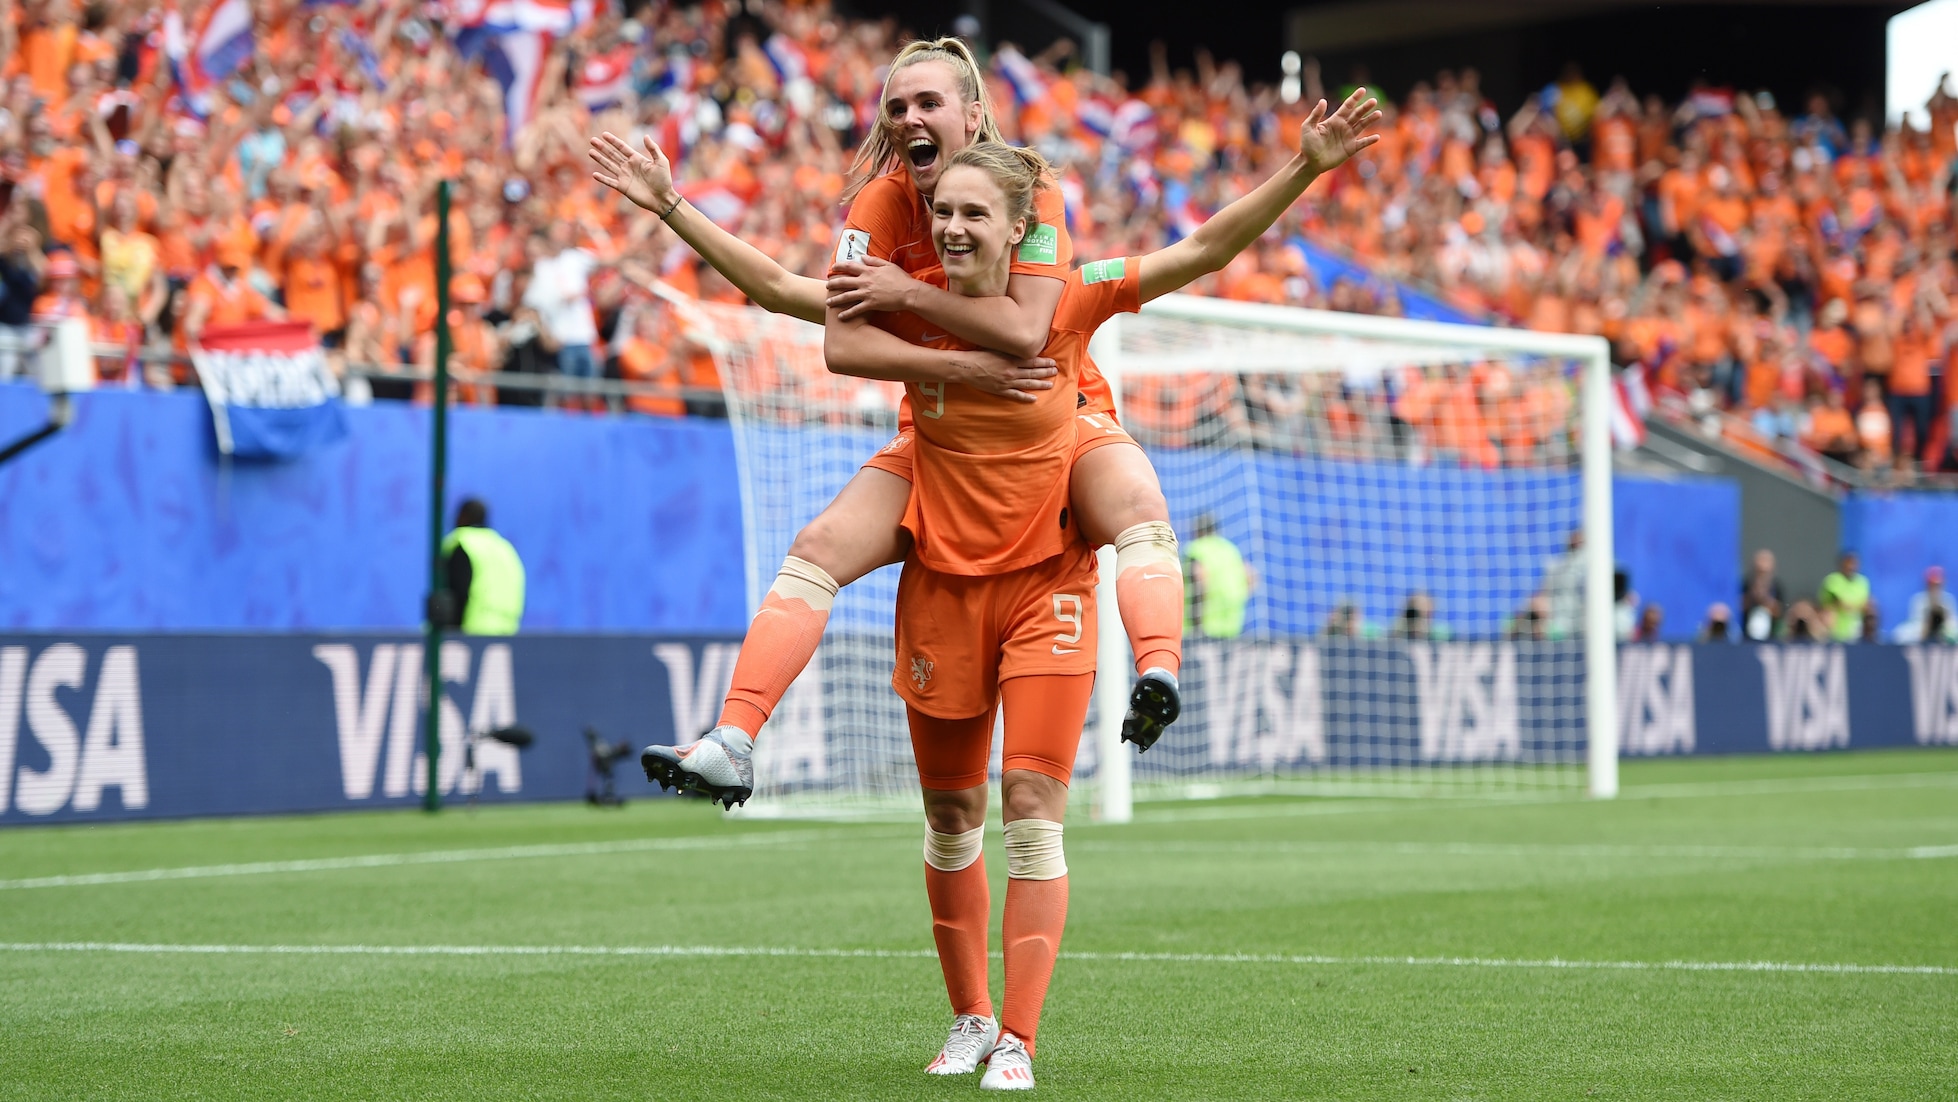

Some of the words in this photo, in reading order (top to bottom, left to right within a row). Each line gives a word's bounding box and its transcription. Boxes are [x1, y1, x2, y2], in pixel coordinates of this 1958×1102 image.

[1028, 234, 1054, 242] IVING
[1053, 593, 1083, 644] 9
[0, 642, 149, 816] ISA
[312, 641, 523, 799] VISA
[1198, 642, 1325, 766] VISA
[1411, 641, 1518, 760] VISA
[1755, 644, 1849, 750] VISA
